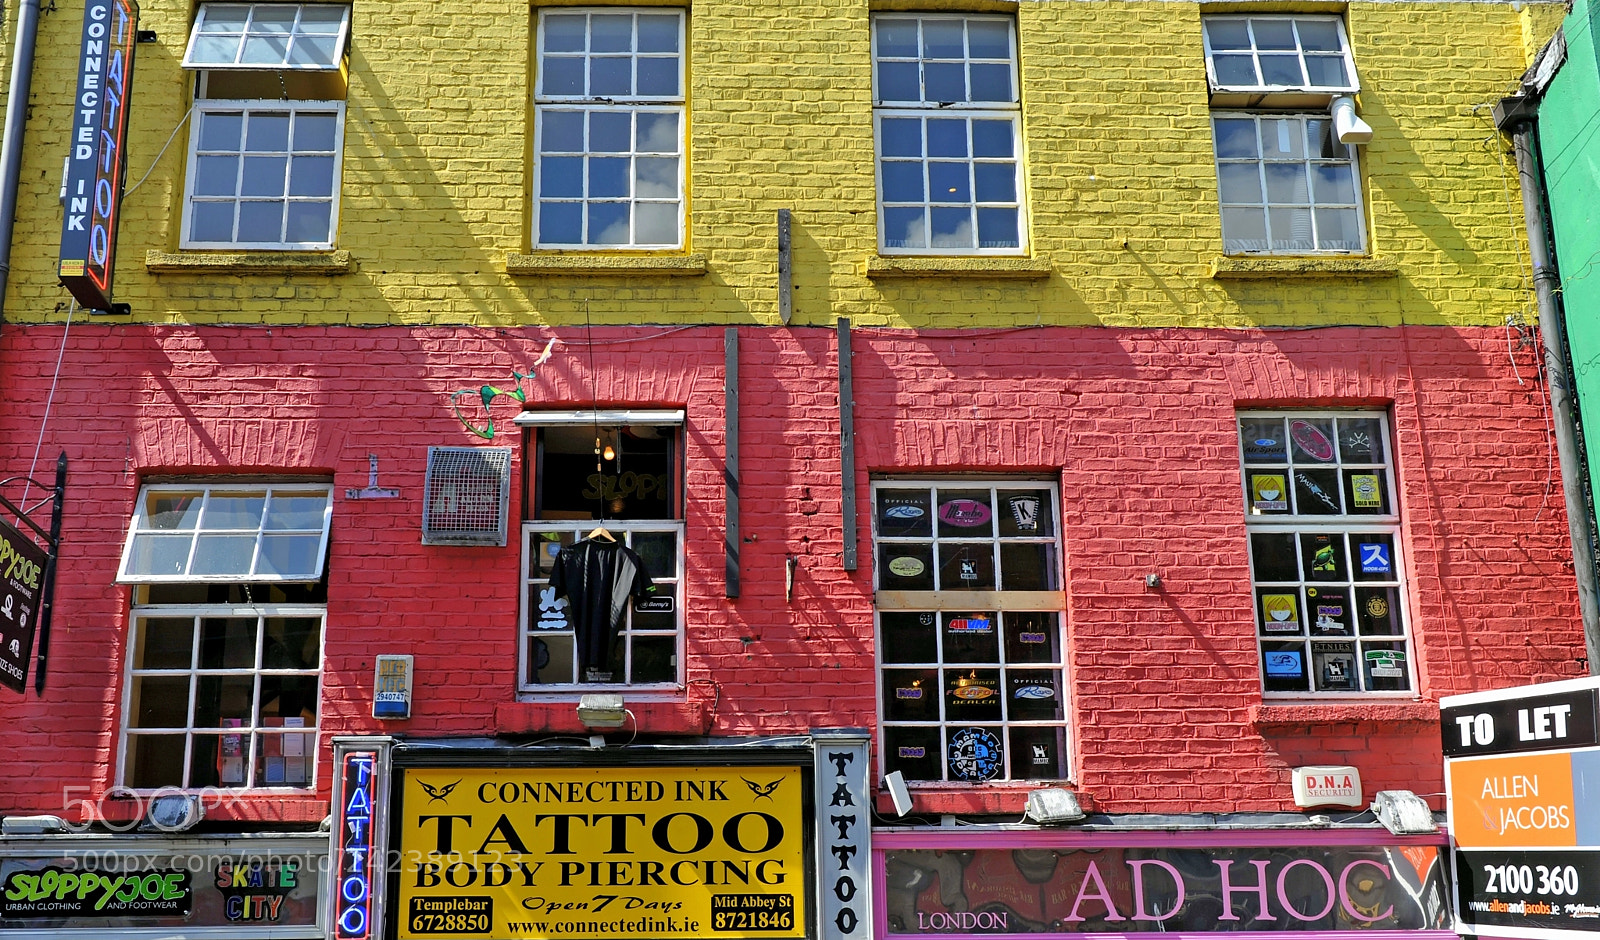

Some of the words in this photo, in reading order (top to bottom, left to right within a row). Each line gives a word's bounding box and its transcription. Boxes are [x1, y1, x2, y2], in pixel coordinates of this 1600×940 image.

[75, 5, 106, 160] CONNECTED
[92, 1, 128, 265] TATTOO
[68, 179, 88, 231] INK
[1456, 713, 1495, 747] TO
[1518, 704, 1571, 741] LET
[478, 781, 665, 803] CONNECTED
[674, 780, 729, 801] INK
[1306, 776, 1352, 789] D.N.A
[1481, 775, 1539, 799] ALLEN
[1499, 805, 1570, 836] JACOBS
[343, 758, 372, 933] TATTOO
[418, 812, 785, 856] TATTOO
[829, 752, 859, 935] TATTOO
[217, 863, 297, 888] SKATE
[413, 860, 545, 888] BODY
[557, 859, 788, 887] PIERCING
[1484, 865, 1534, 895] 2100
[1536, 865, 1579, 895] 360
[714, 896, 738, 908] Mid
[741, 896, 776, 910] Abbey
[778, 895, 791, 908] St
[1064, 859, 1185, 921] AD
[1212, 859, 1394, 921] HOC
[5, 902, 35, 911] URBAN
[37, 902, 81, 911] CLOTHING
[107, 901, 127, 909] AND
[128, 900, 178, 909] FOOTWEAR
[226, 895, 286, 921] CITY
[414, 898, 488, 914] Templebar
[521, 897, 589, 915] Open
[591, 895, 619, 914] 7
[619, 896, 683, 913] Days
[1468, 899, 1561, 917] www.allenandjacobs.ie
[413, 914, 489, 931] 6728850
[507, 917, 699, 933] www.connectedink.ie
[715, 911, 791, 929] 8721846
[917, 912, 1008, 930] LONDON
